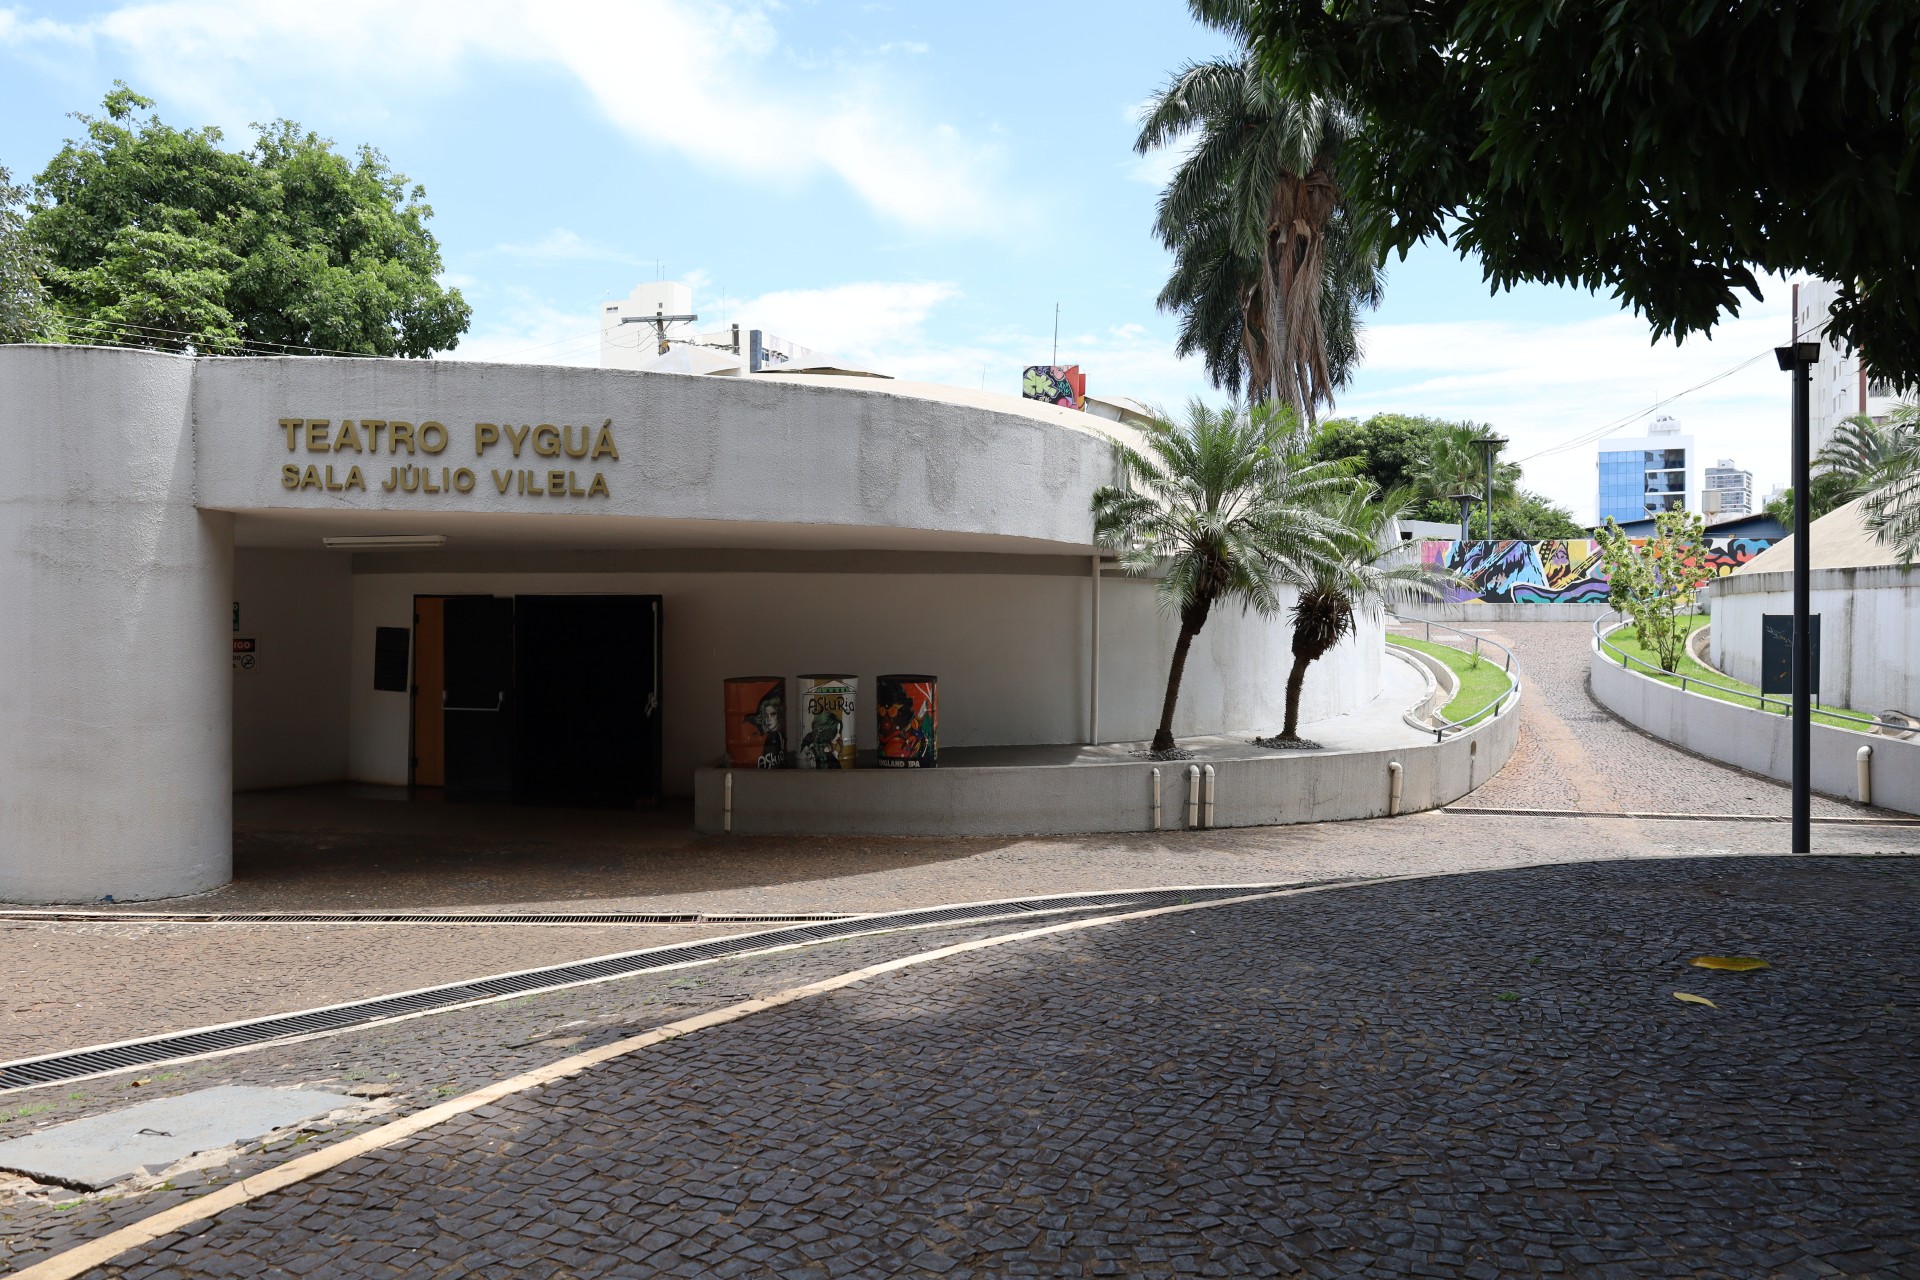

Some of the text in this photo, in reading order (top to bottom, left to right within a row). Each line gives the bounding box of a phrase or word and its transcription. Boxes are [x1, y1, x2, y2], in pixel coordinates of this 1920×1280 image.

[278, 418, 619, 461] TEATRO PYGUÁ
[280, 463, 610, 498] SALA JÚLIO VILELA
[908, 760, 921, 768] IPA
